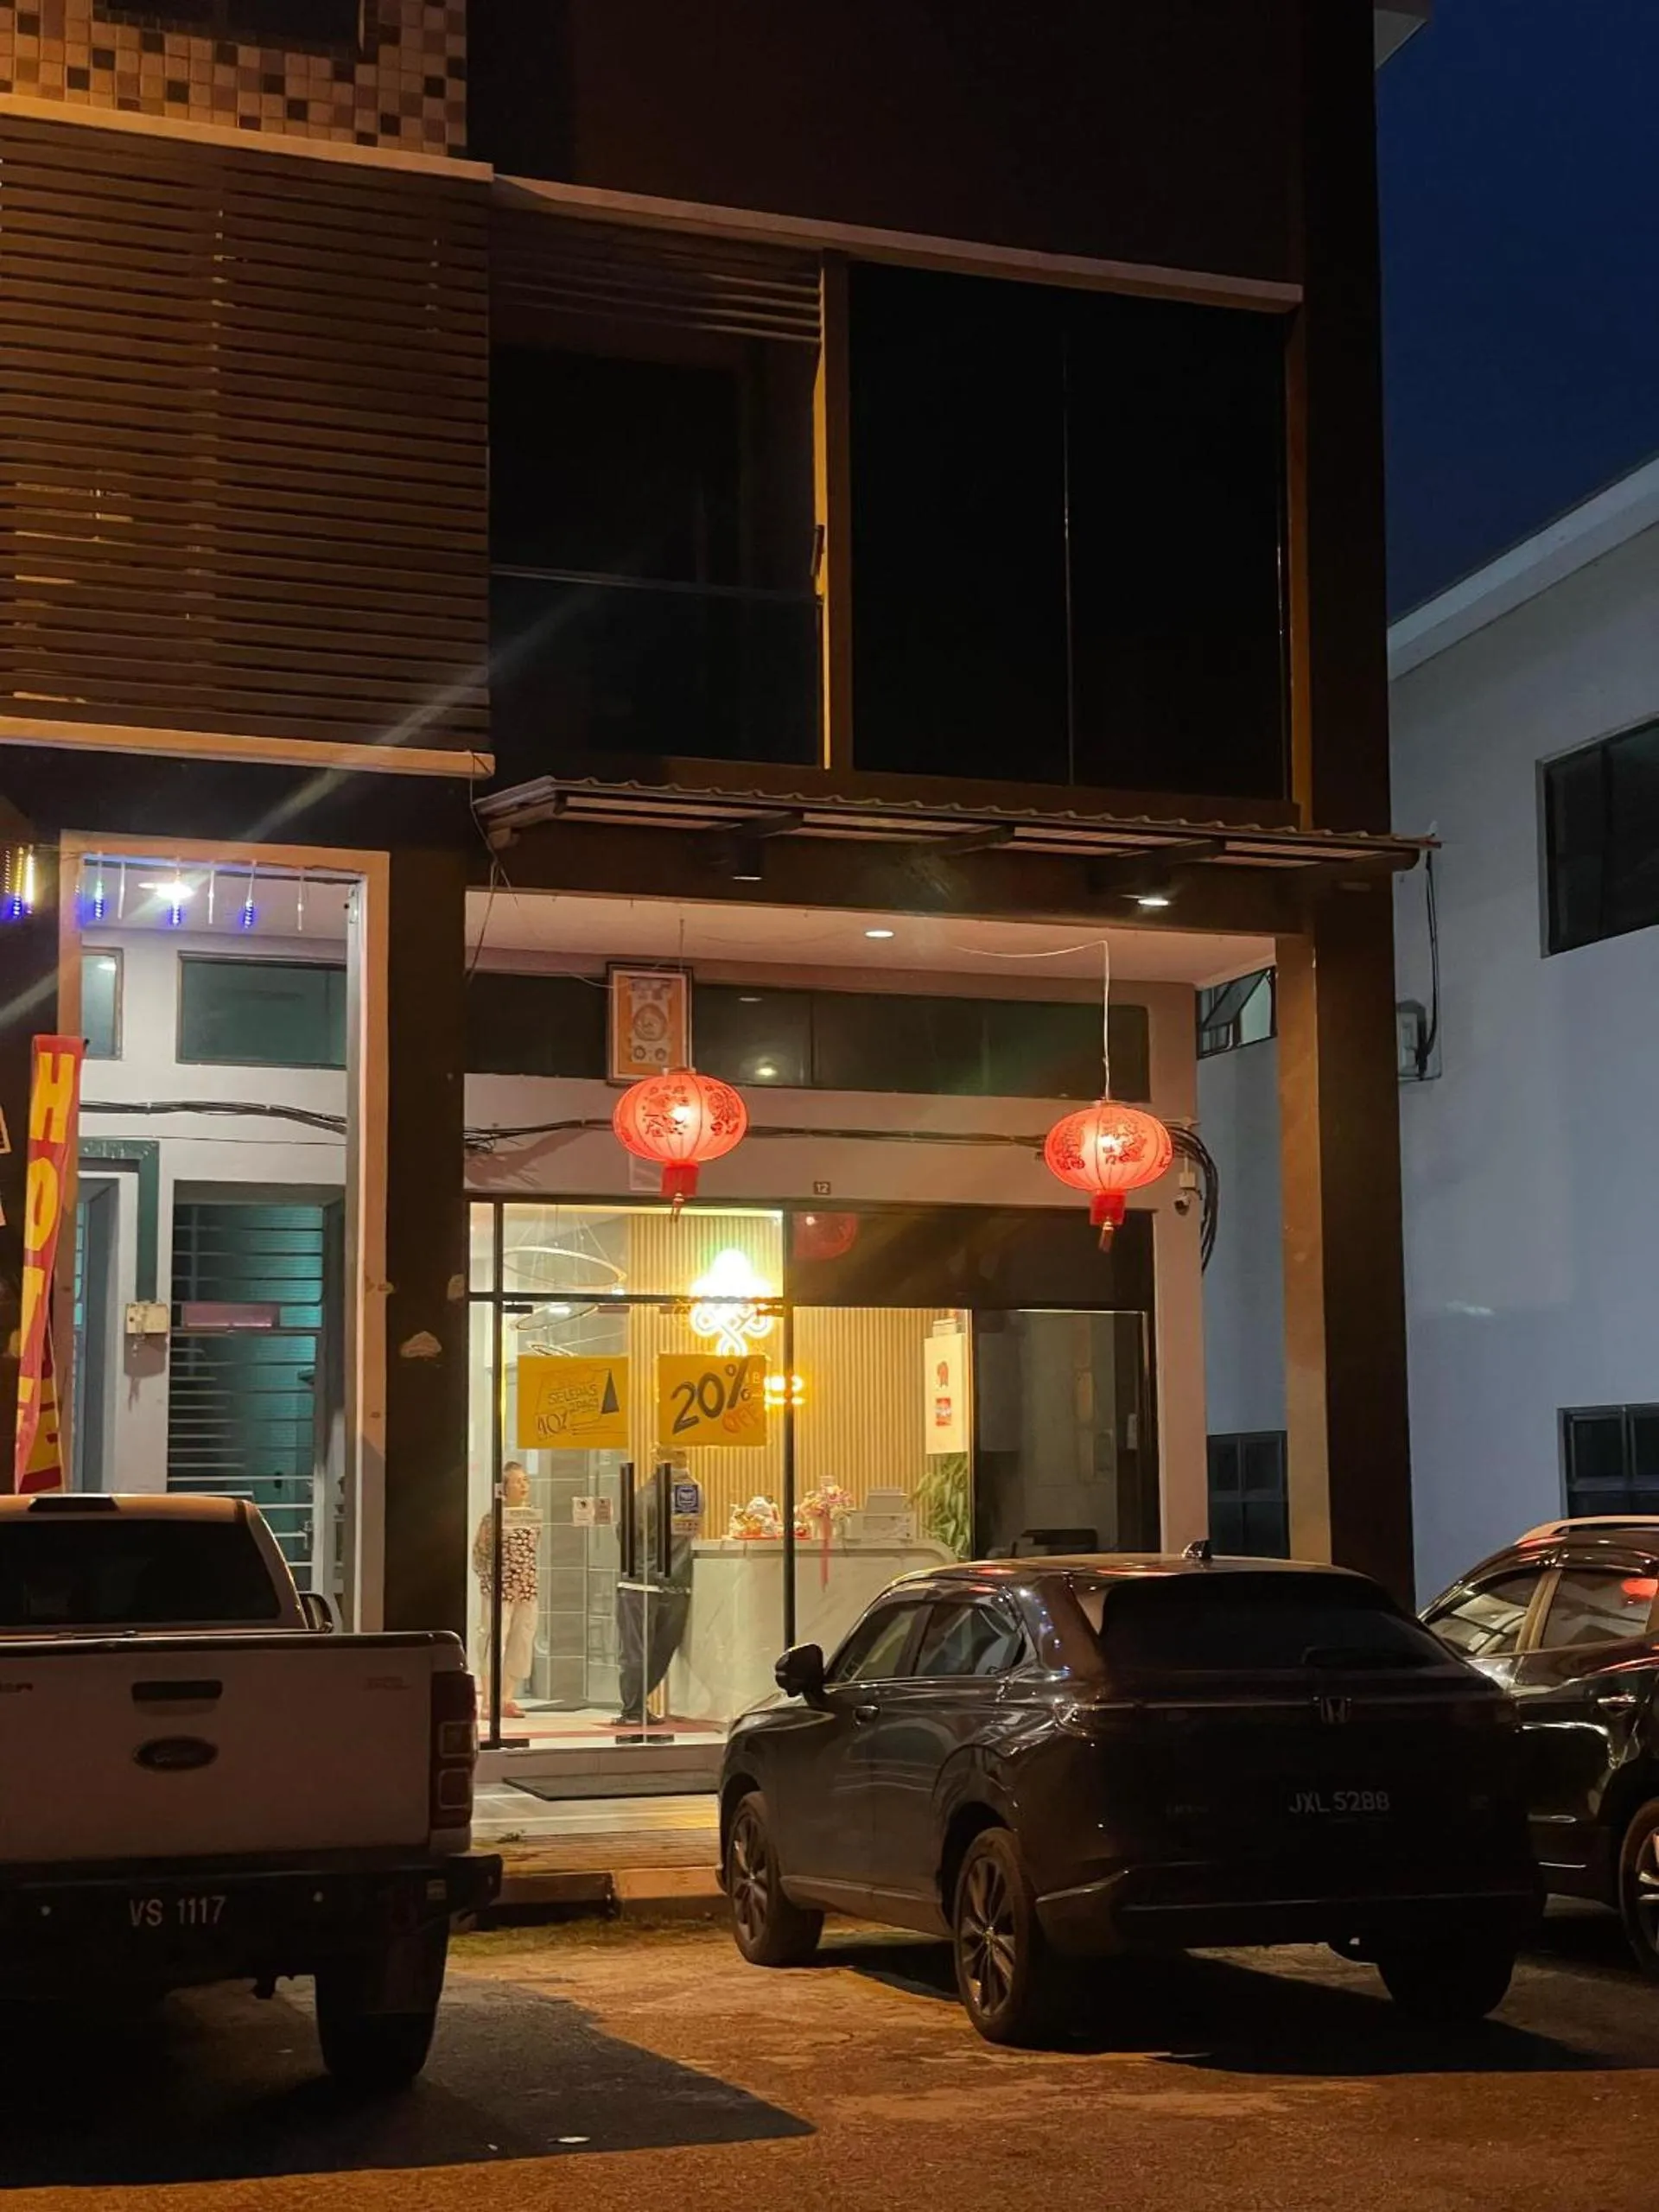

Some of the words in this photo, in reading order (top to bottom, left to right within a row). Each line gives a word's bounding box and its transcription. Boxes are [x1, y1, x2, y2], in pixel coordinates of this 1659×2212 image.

[817, 1183, 829, 1193] 12
[670, 1357, 752, 1435] 20%
[1288, 1791, 1331, 1814] JXL
[1333, 1790, 1390, 1812] 5288
[129, 1897, 164, 1928] VS
[175, 1894, 227, 1926] 1117
